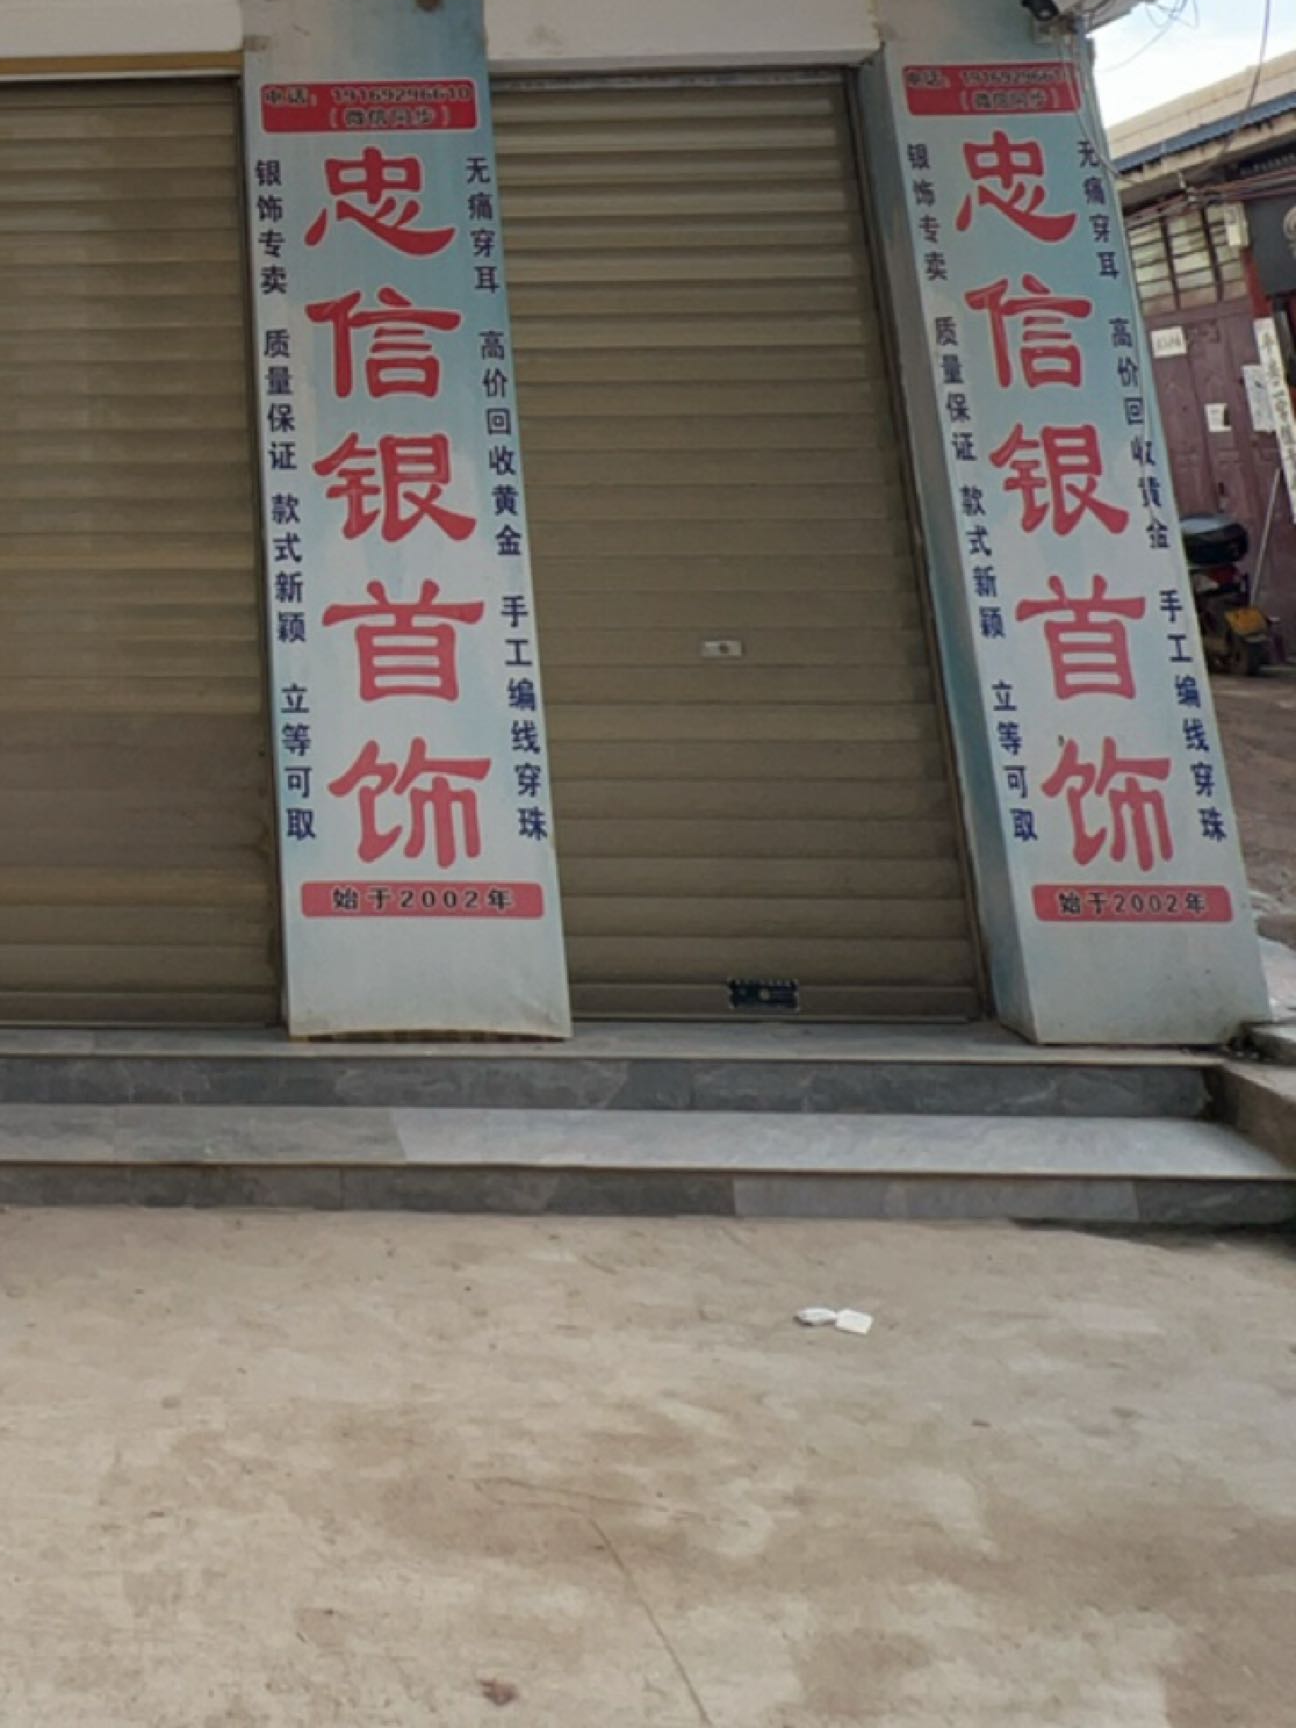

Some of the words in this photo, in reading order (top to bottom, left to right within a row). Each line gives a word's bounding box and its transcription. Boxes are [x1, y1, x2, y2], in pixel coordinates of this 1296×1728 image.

[255, 158, 288, 295] 银饰专卖
[465, 156, 500, 294] 无痛穿耳
[264, 329, 298, 471] 质量保证
[478, 330, 522, 556] 高价回收黄金
[272, 493, 306, 643] 款式新颖
[304, 145, 492, 870] 忠信银首饰
[907, 143, 948, 281] 银饰专卖
[934, 315, 977, 462] 质量保证
[960, 485, 1005, 640] 款式新颖
[992, 680, 1038, 843] 立等可取
[956, 129, 1174, 873] 忠信银首饰
[1077, 139, 1120, 279] 无痛穿耳
[1159, 589, 1227, 843] 手工编线穿珠
[280, 682, 316, 841] 立等可取
[500, 595, 548, 842] 手工编线穿珠
[332, 885, 515, 911] 始于2002年
[1058, 891, 1207, 916] 始于2002年
